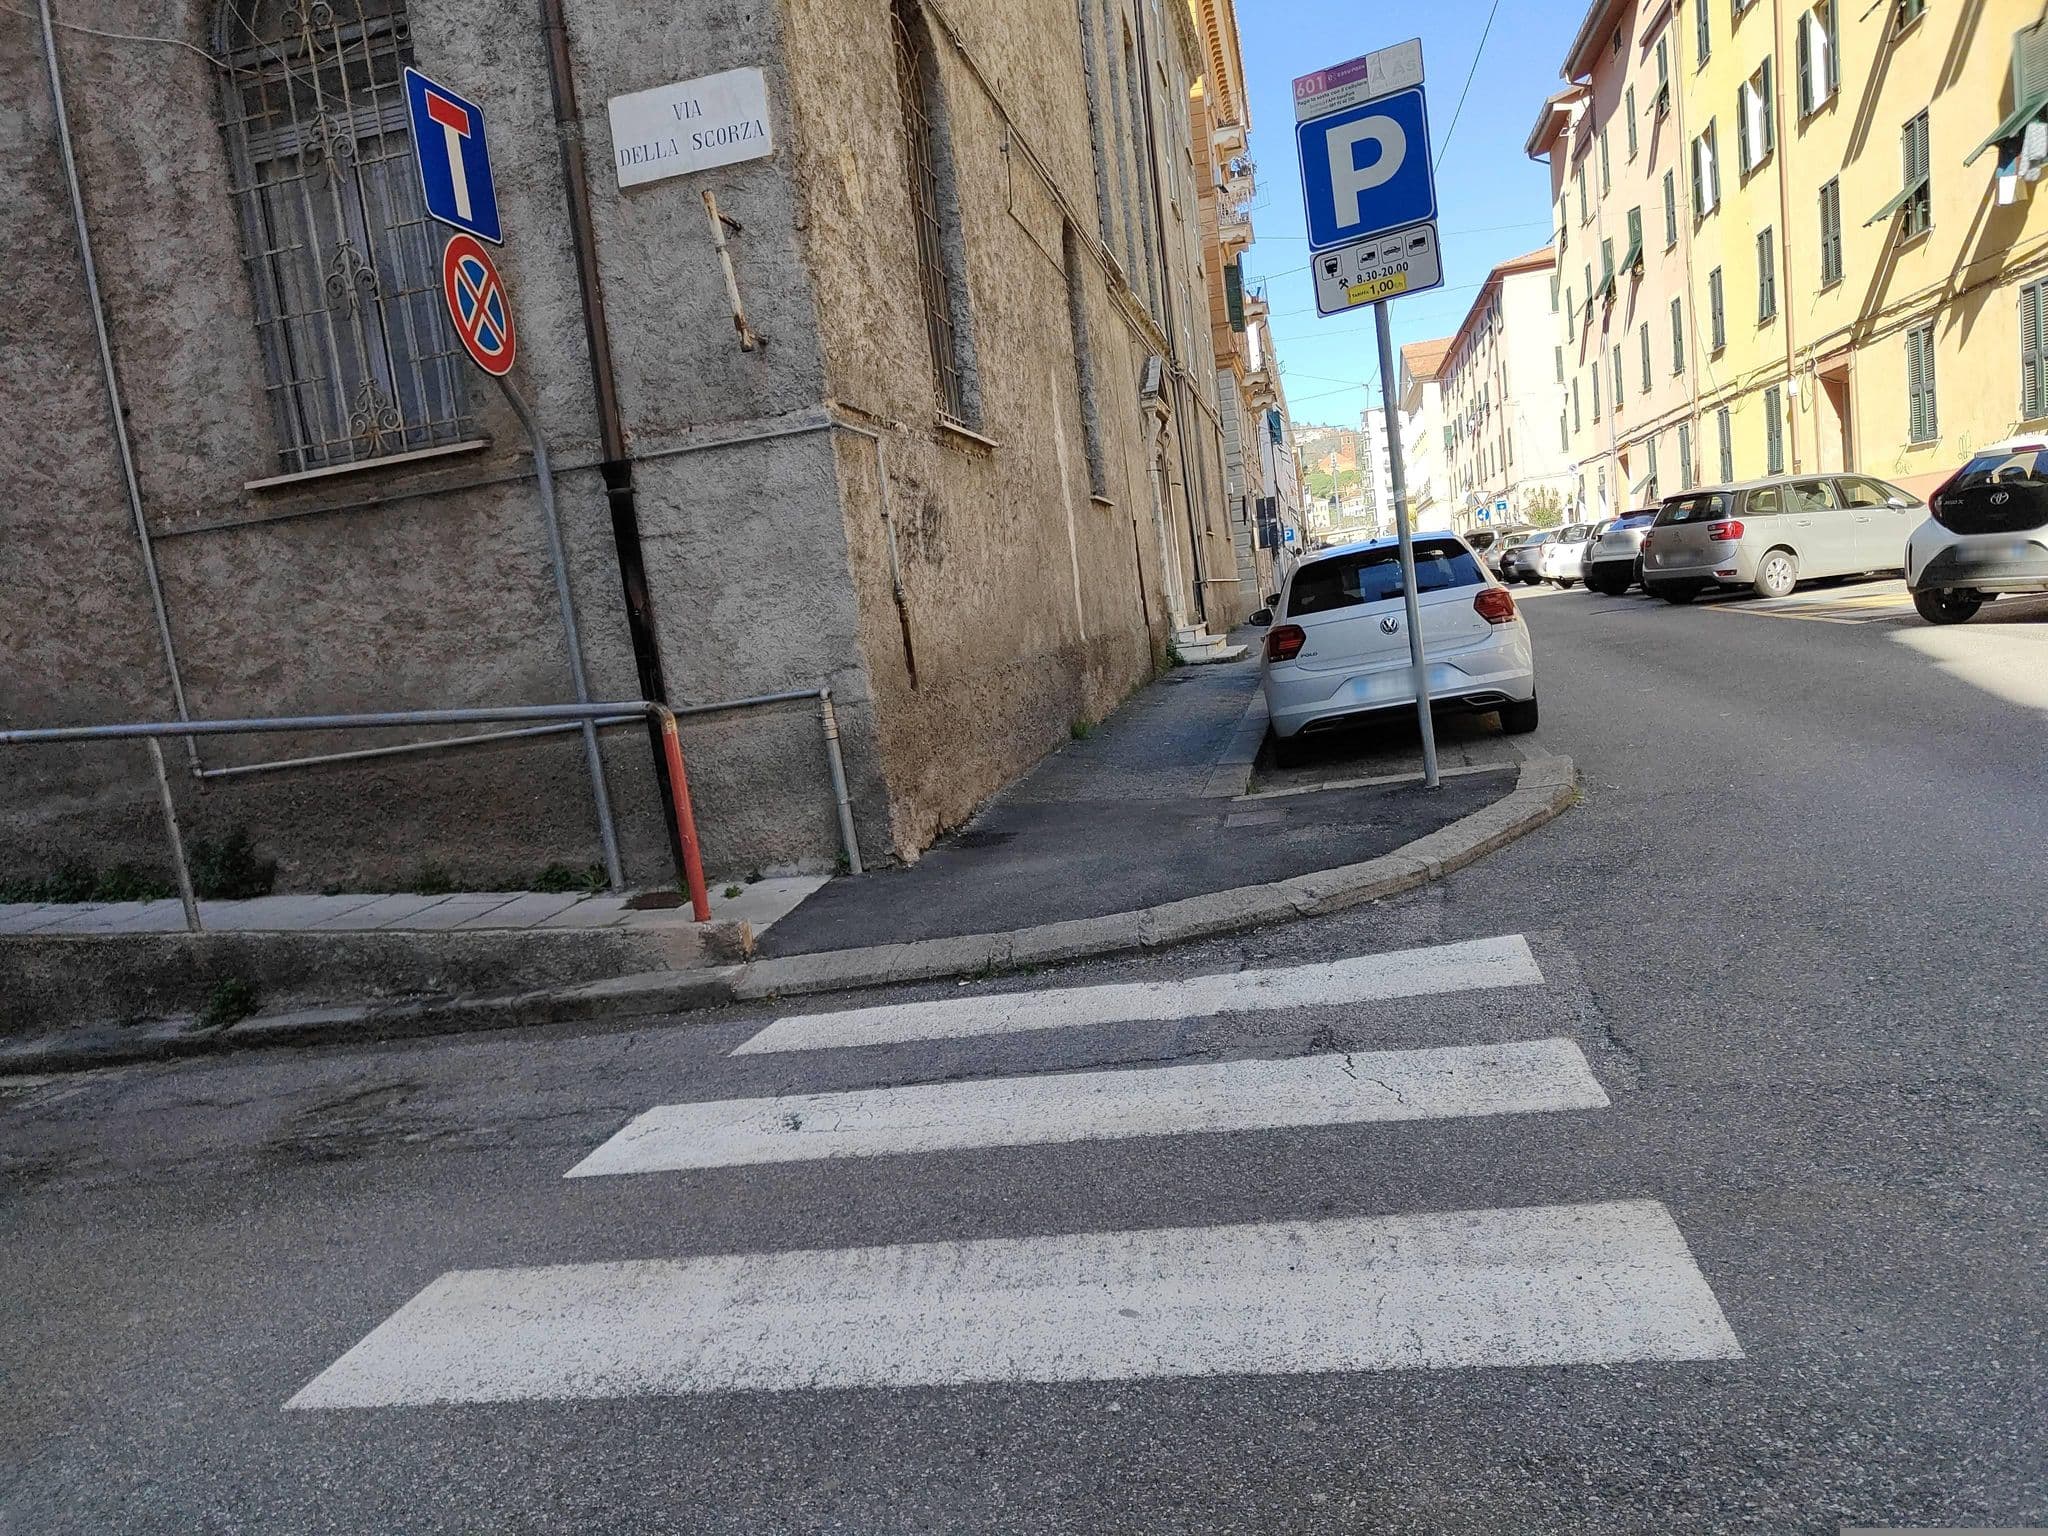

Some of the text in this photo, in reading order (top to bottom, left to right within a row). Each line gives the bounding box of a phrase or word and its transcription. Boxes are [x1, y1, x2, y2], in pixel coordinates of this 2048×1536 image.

[1296, 76, 1324, 97] 601
[672, 99, 702, 121] VIA
[620, 119, 765, 167] DELLA SCORZA
[1325, 114, 1407, 229] P
[1357, 261, 1409, 284] 8.30-20.00
[1370, 279, 1394, 296] 1,00
